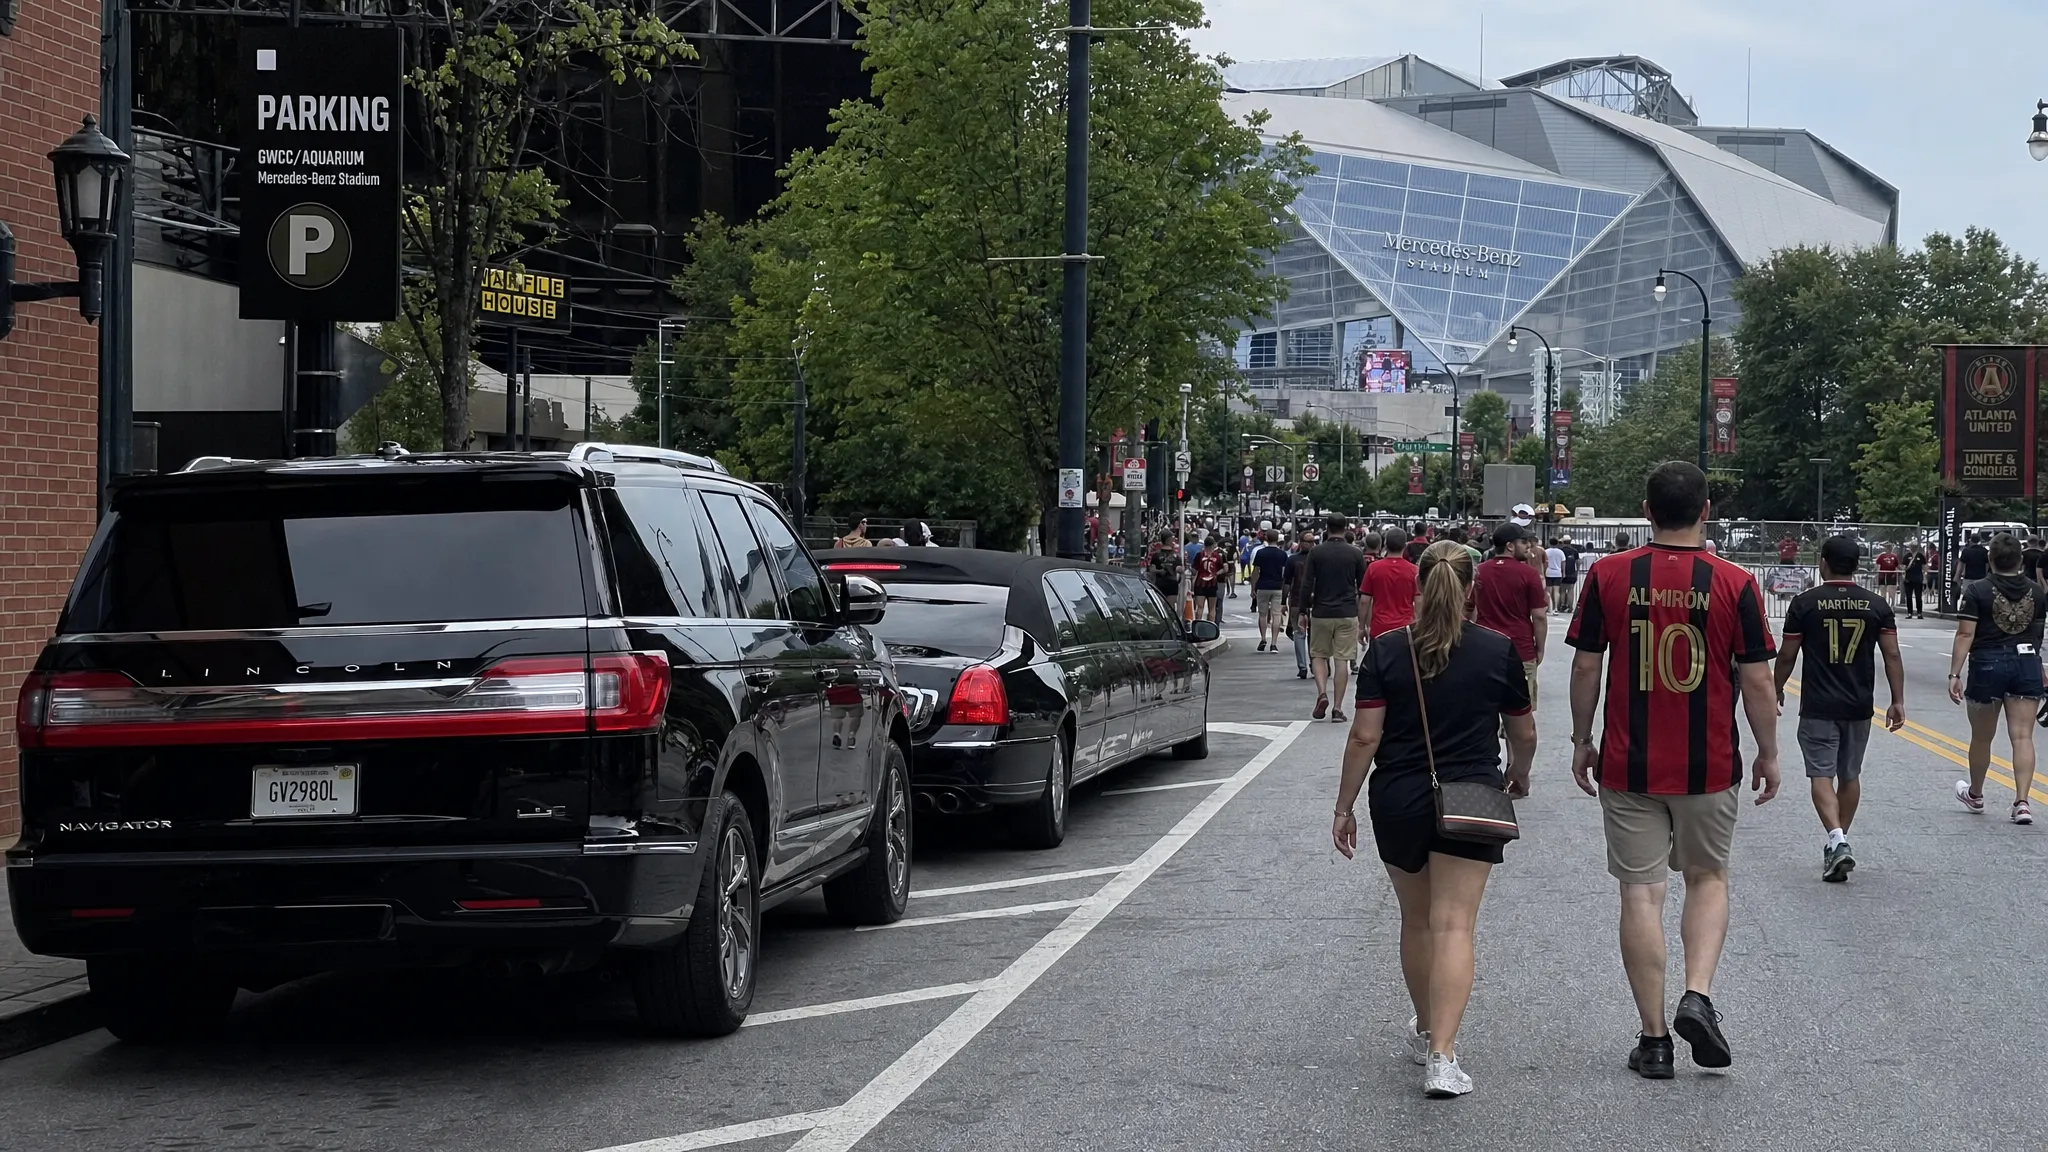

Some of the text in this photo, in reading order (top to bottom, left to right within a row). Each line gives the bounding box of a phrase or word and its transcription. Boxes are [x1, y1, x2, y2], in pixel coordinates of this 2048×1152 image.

[258, 94, 390, 132] PARKING
[258, 149, 364, 167] GWCC/AQUARIUM
[258, 171, 380, 186] Mercedes-Benz Stadium
[289, 214, 335, 274] P
[1382, 231, 1522, 268] Mercedes-Benz
[1407, 258, 1489, 280] STADIUM
[484, 293, 555, 318] HOUSE
[1964, 409, 2017, 421] ATLANTA
[1969, 421, 2012, 433] UNITED
[1965, 453, 2016, 465] UNITE &
[1963, 465, 2017, 477] CONQUER
[1627, 586, 1710, 611] ALMIRÓN
[1817, 597, 1871, 611] MARTÍNEZ
[1823, 618, 1866, 664] 17
[1631, 619, 1706, 694] 10
[161, 660, 452, 678] LINCOLN
[269, 779, 339, 803] GV2980L
[60, 820, 172, 832] NAVIGATOR
